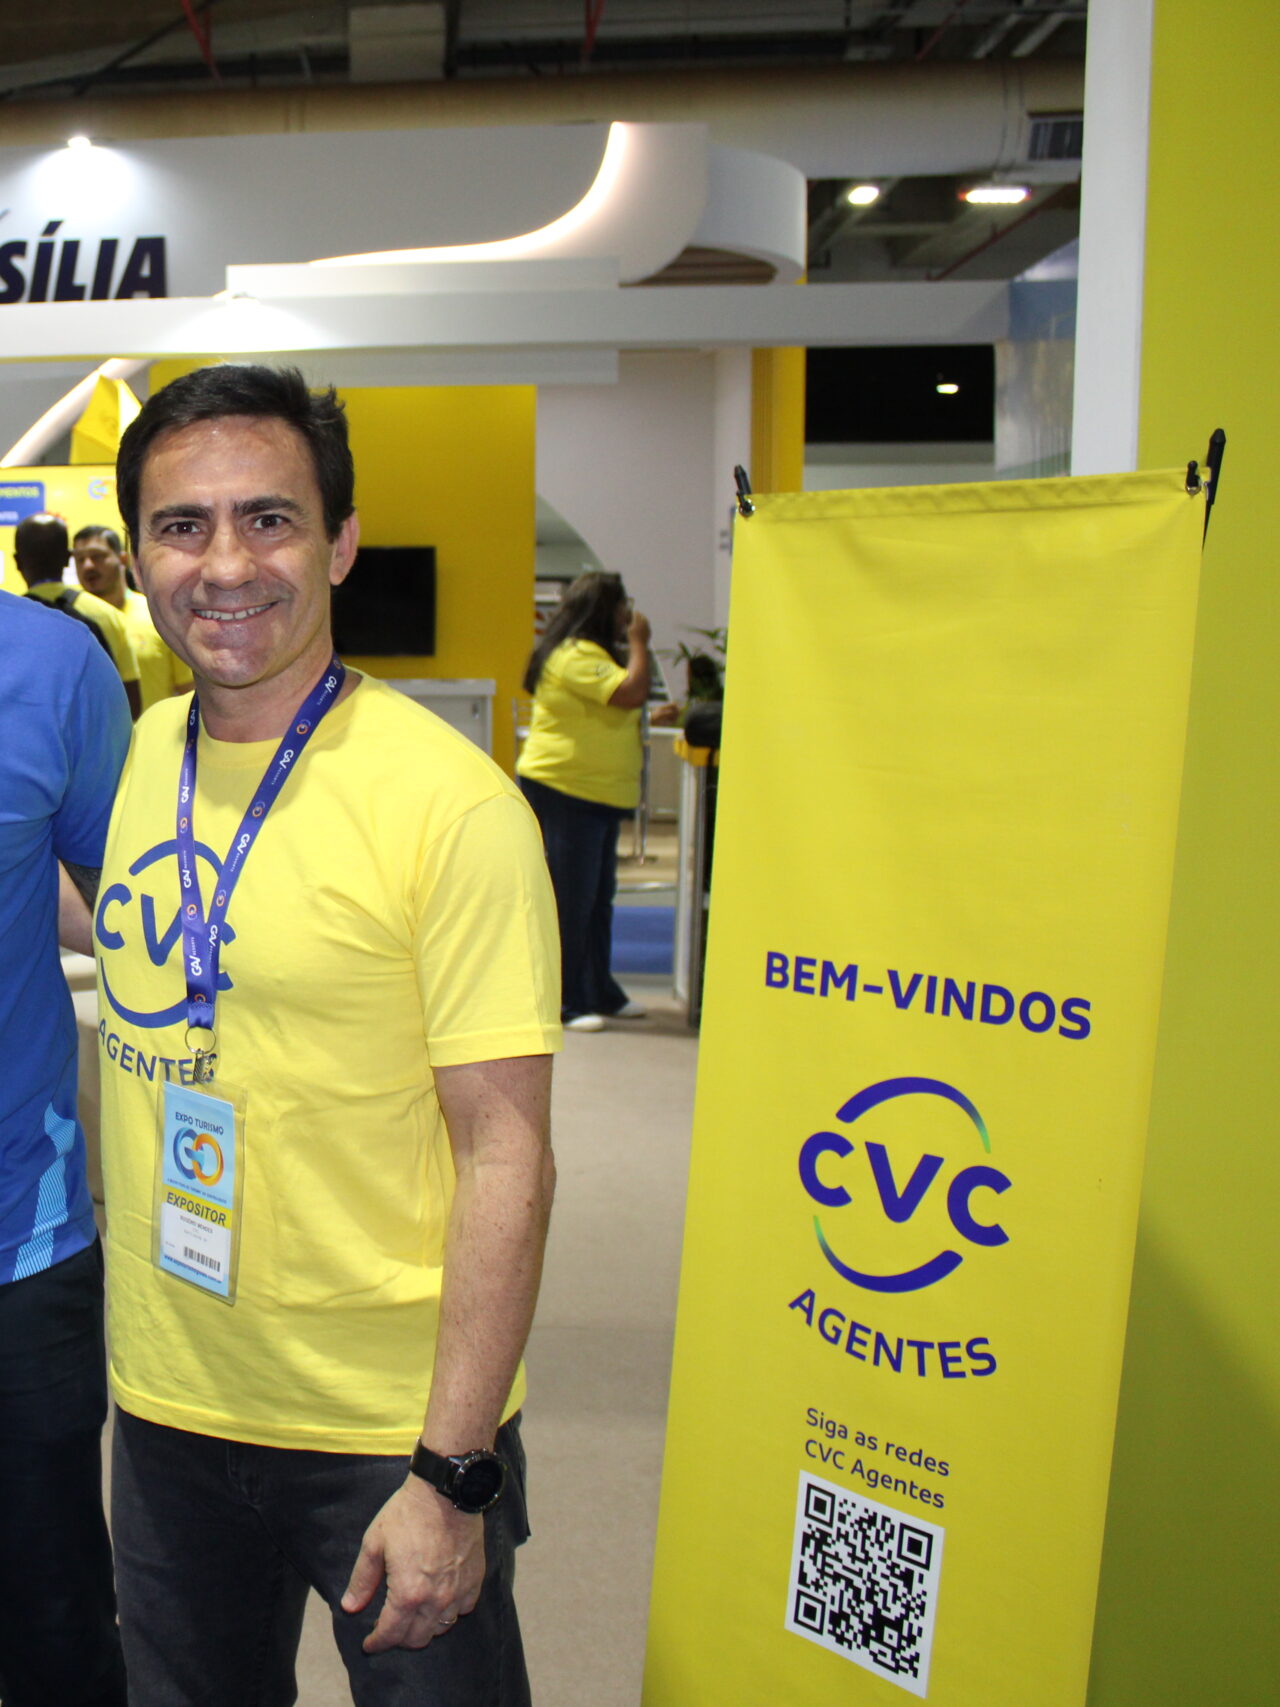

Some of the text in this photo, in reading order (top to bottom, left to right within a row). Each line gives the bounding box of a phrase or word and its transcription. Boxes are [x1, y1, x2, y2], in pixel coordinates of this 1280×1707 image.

[764, 950, 1092, 1041] BEM-VINDOS
[175, 1111, 224, 1136] EXPO TURISMO
[166, 1191, 227, 1227] EXPOSITOR
[798, 1131, 1013, 1247] CVC
[788, 1287, 998, 1379] AGENTES
[805, 1439, 945, 1509] CVC Agentes
[806, 1407, 950, 1477] Siga as redes
